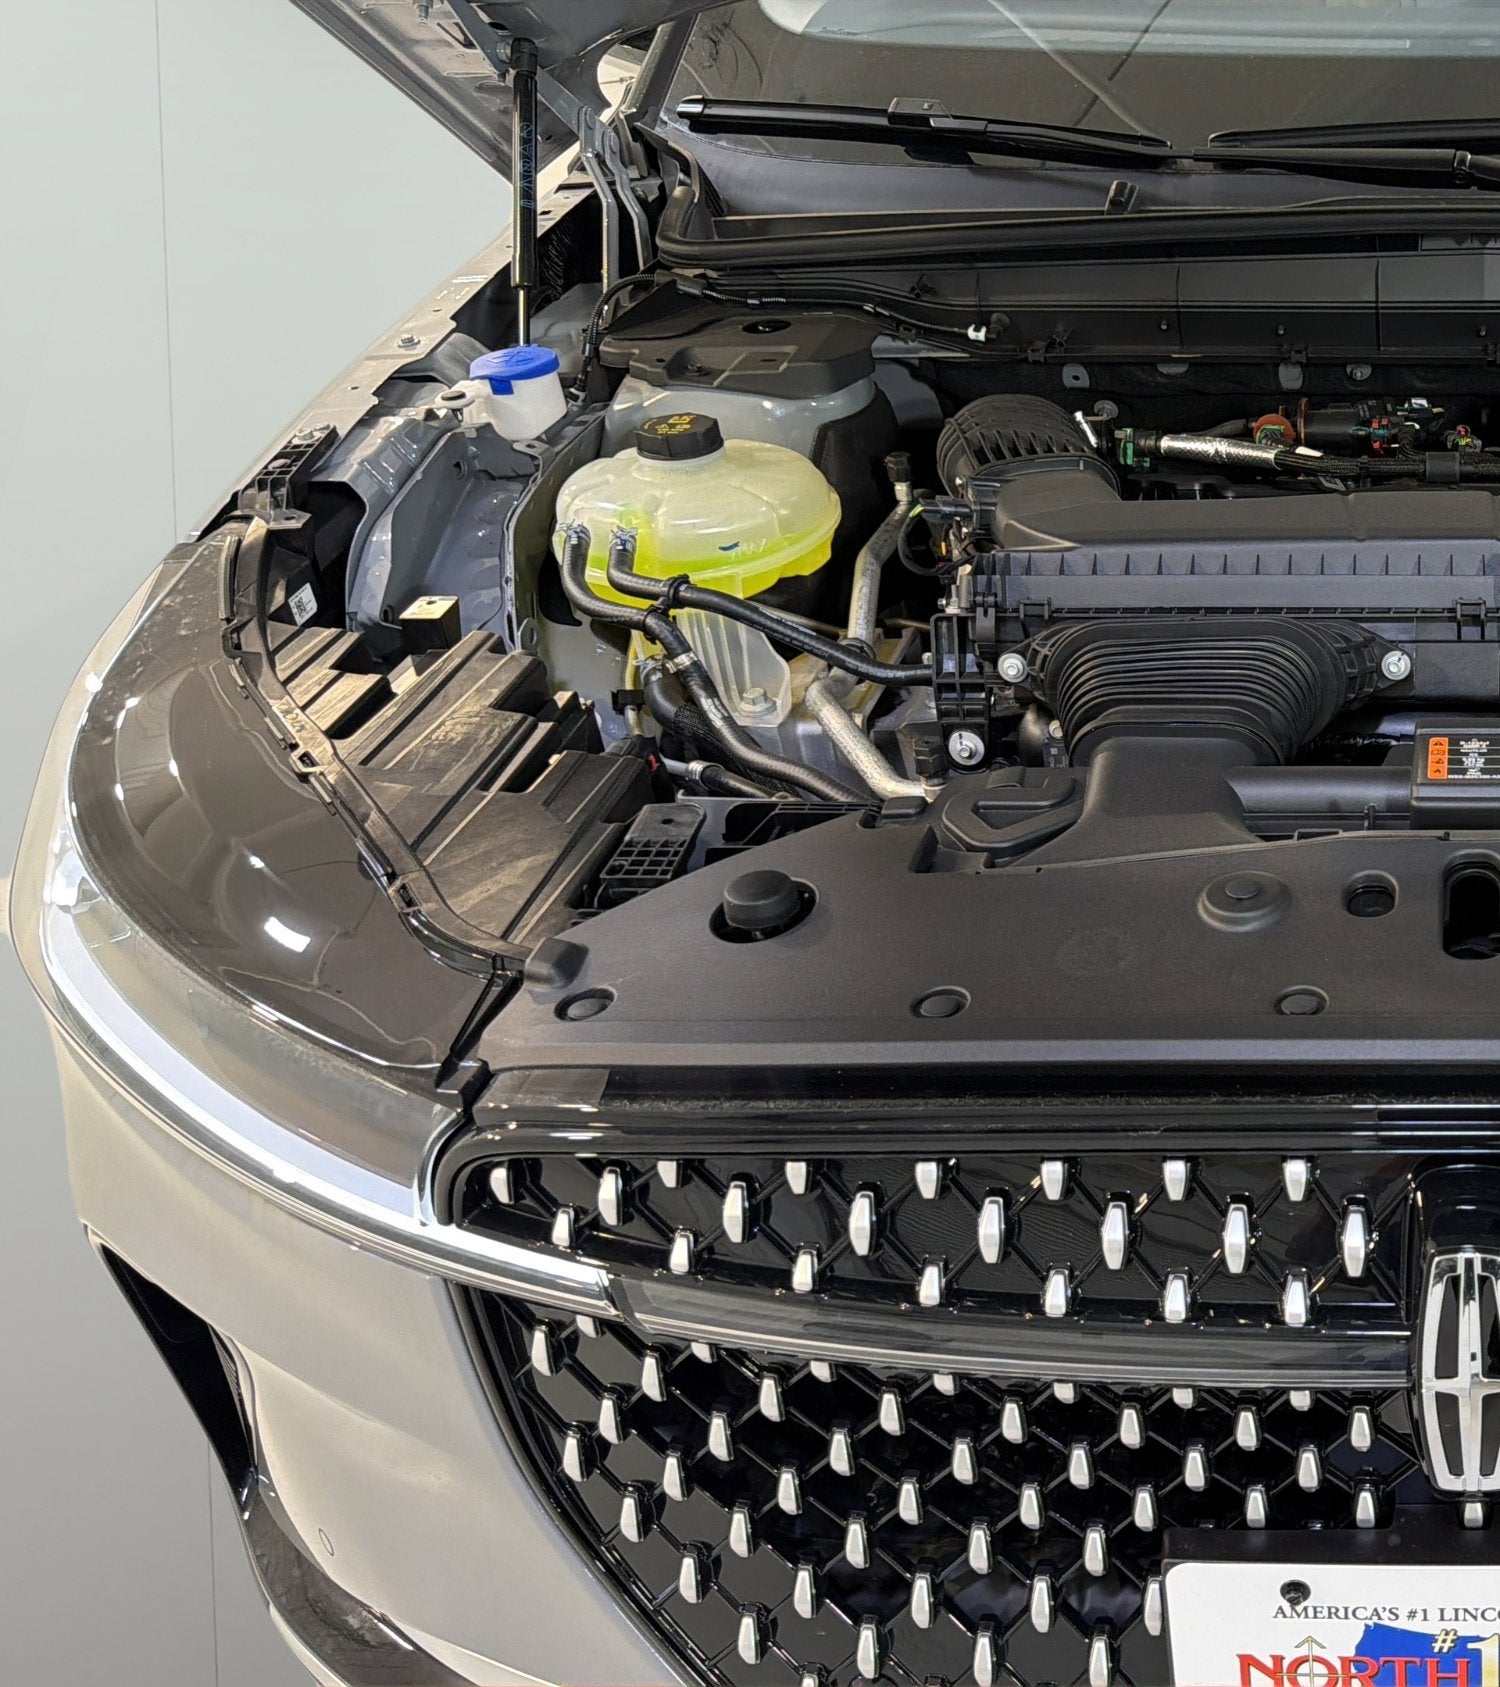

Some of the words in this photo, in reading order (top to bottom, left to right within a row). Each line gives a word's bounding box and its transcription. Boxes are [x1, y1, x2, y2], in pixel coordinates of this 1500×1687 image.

[1272, 1605, 1400, 1622] AMERICA'S
[1406, 1607, 1430, 1622] #1
[1236, 1653, 1470, 1687] NORTH
